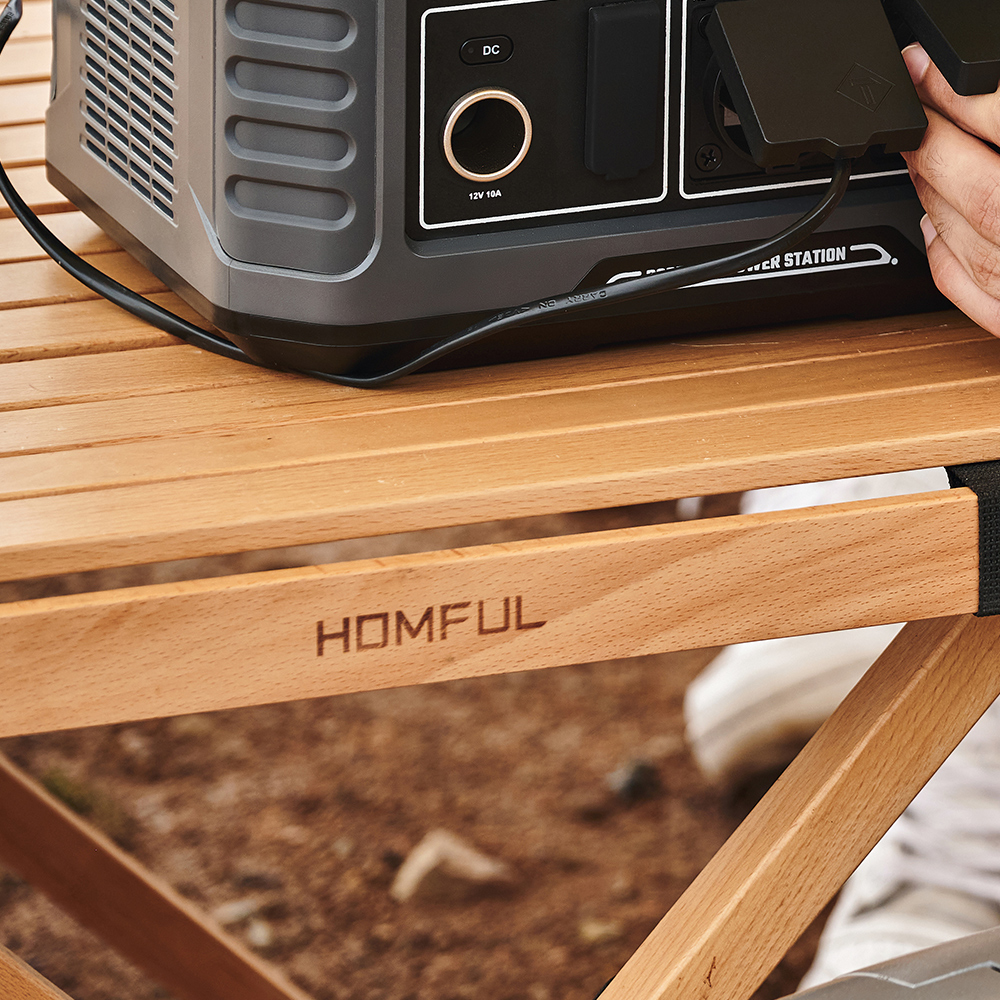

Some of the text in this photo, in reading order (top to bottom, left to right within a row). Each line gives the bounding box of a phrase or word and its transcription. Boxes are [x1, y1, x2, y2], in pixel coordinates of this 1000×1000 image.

[482, 44, 501, 57] DC
[468, 189, 502, 201] 12V 10A
[783, 246, 847, 269] STATION
[315, 594, 548, 657] HOMFUL
